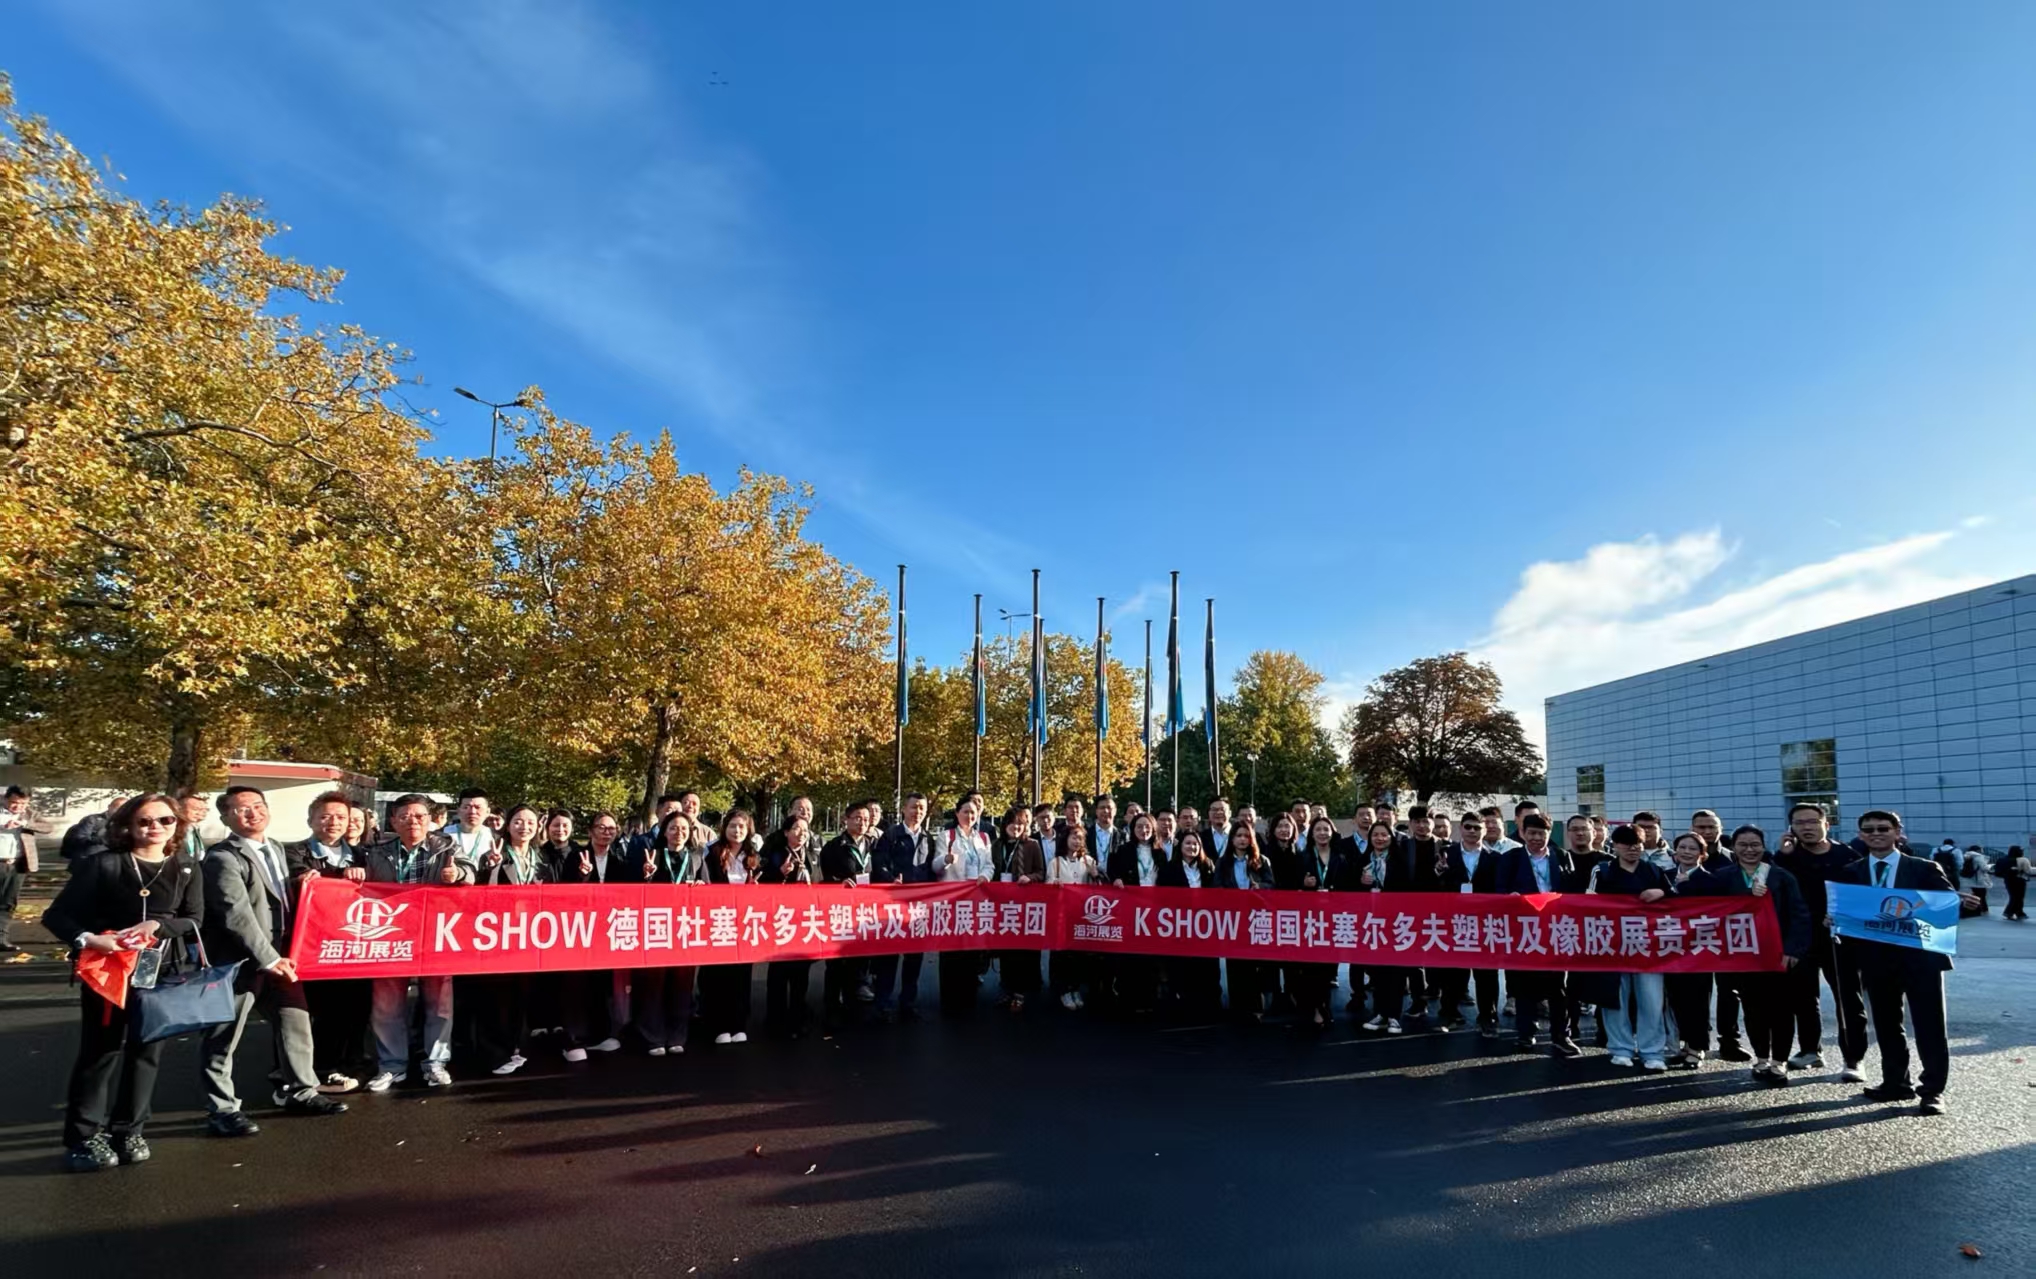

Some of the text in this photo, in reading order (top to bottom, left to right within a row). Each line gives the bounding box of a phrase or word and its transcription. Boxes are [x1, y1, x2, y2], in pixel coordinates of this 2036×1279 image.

[319, 940, 413, 959] 海河展览
[434, 899, 1047, 952] K SHOW 德国杜塞尔多夫塑料及橡胶展贵宾团
[1134, 907, 1760, 957] K SHOW 德国杜塞尔多夫塑料及橡胶展贵宾团
